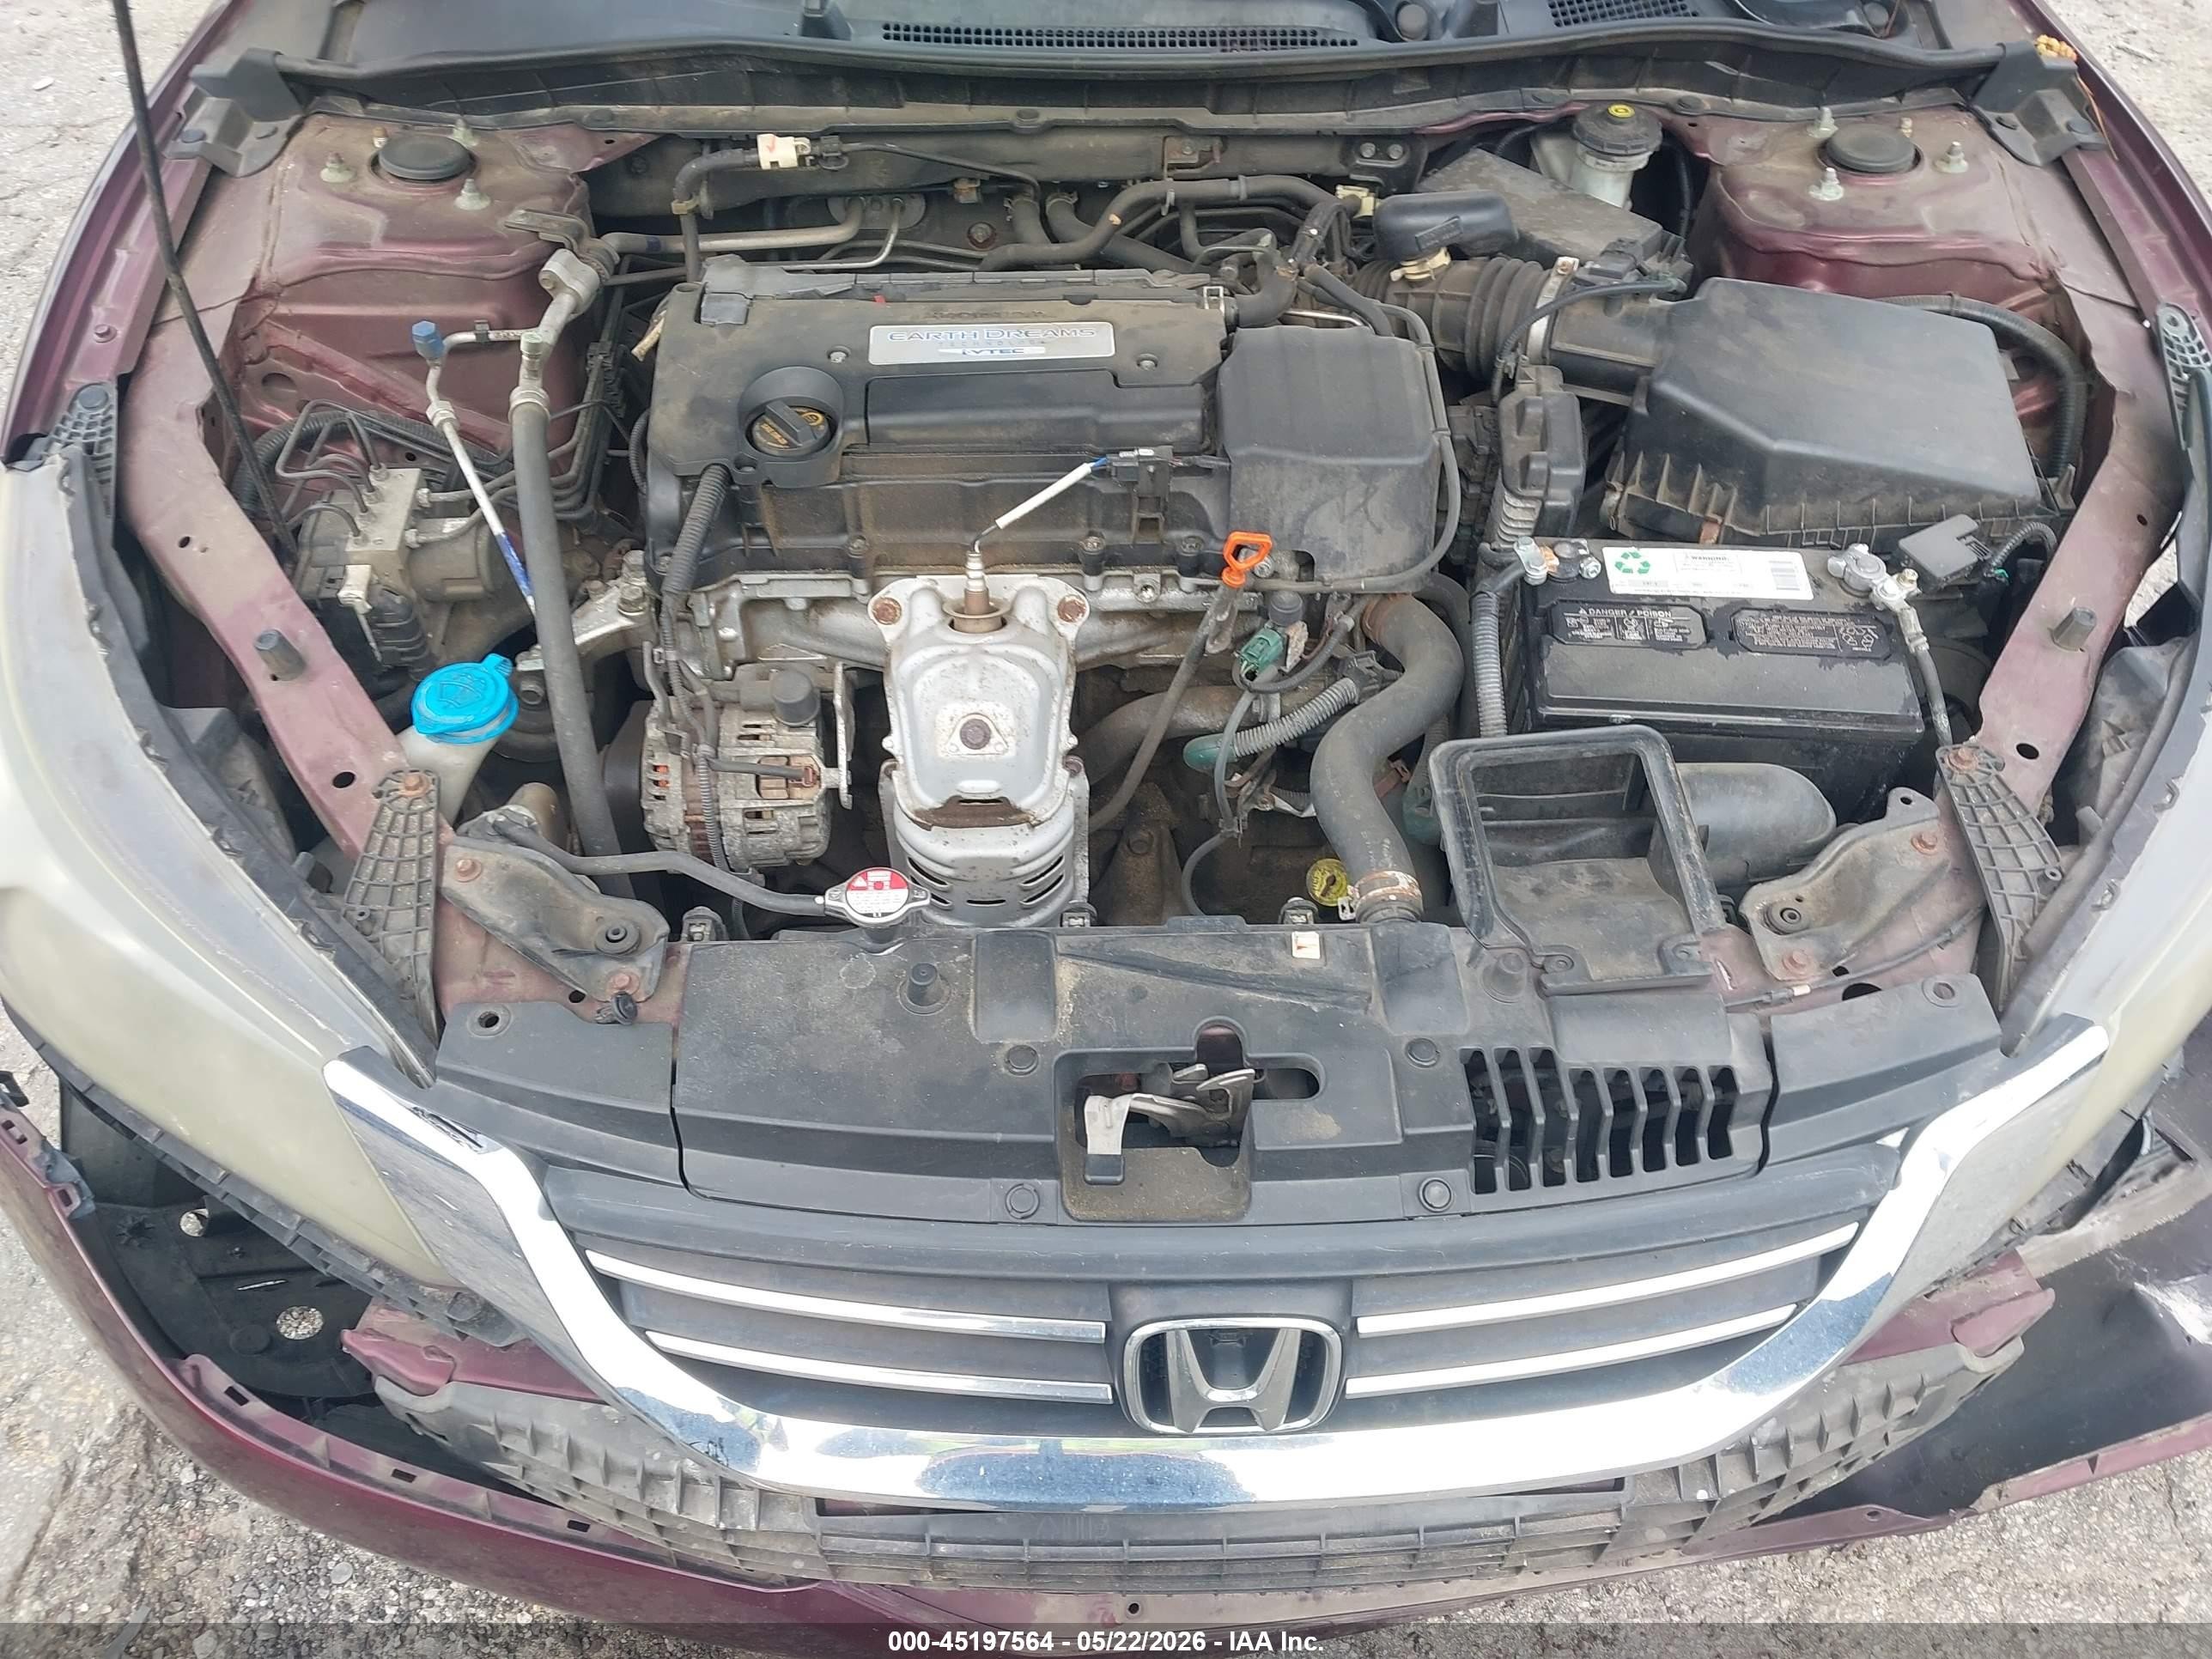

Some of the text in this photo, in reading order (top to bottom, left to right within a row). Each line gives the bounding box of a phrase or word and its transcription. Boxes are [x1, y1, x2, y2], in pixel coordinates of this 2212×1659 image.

[889, 327, 1097, 342] EARTH DREAMS
[1589, 608, 1628, 617] DANGER
[1637, 609, 1673, 617] POISON
